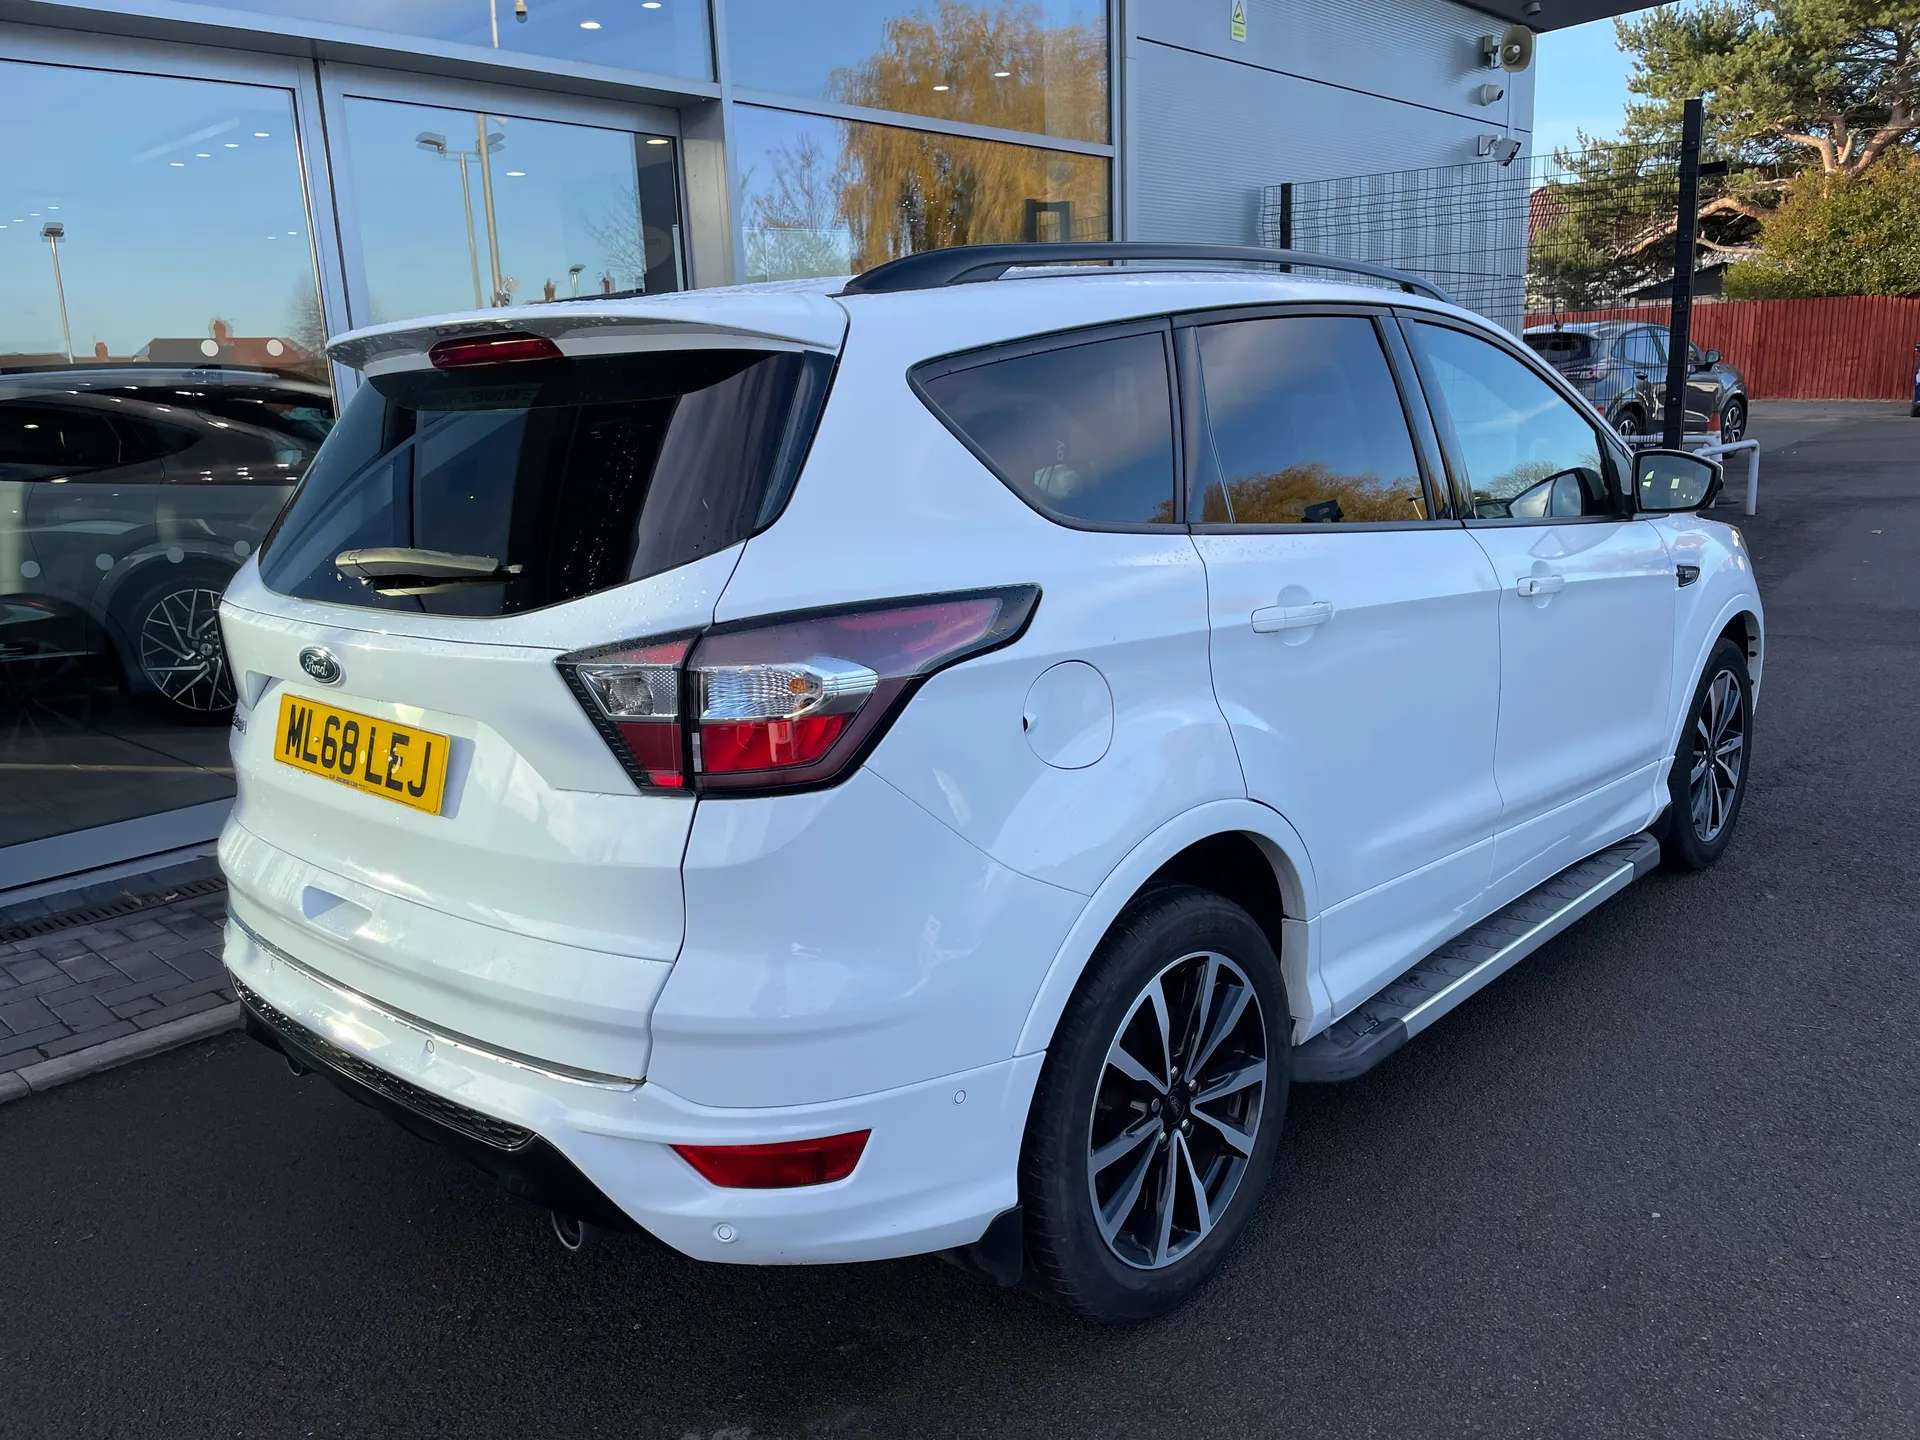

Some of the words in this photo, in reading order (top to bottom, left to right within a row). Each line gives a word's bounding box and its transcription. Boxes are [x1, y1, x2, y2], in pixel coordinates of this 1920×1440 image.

[304, 654, 328, 677] Ford
[285, 704, 360, 775] ML68
[364, 726, 432, 798] LEJ
